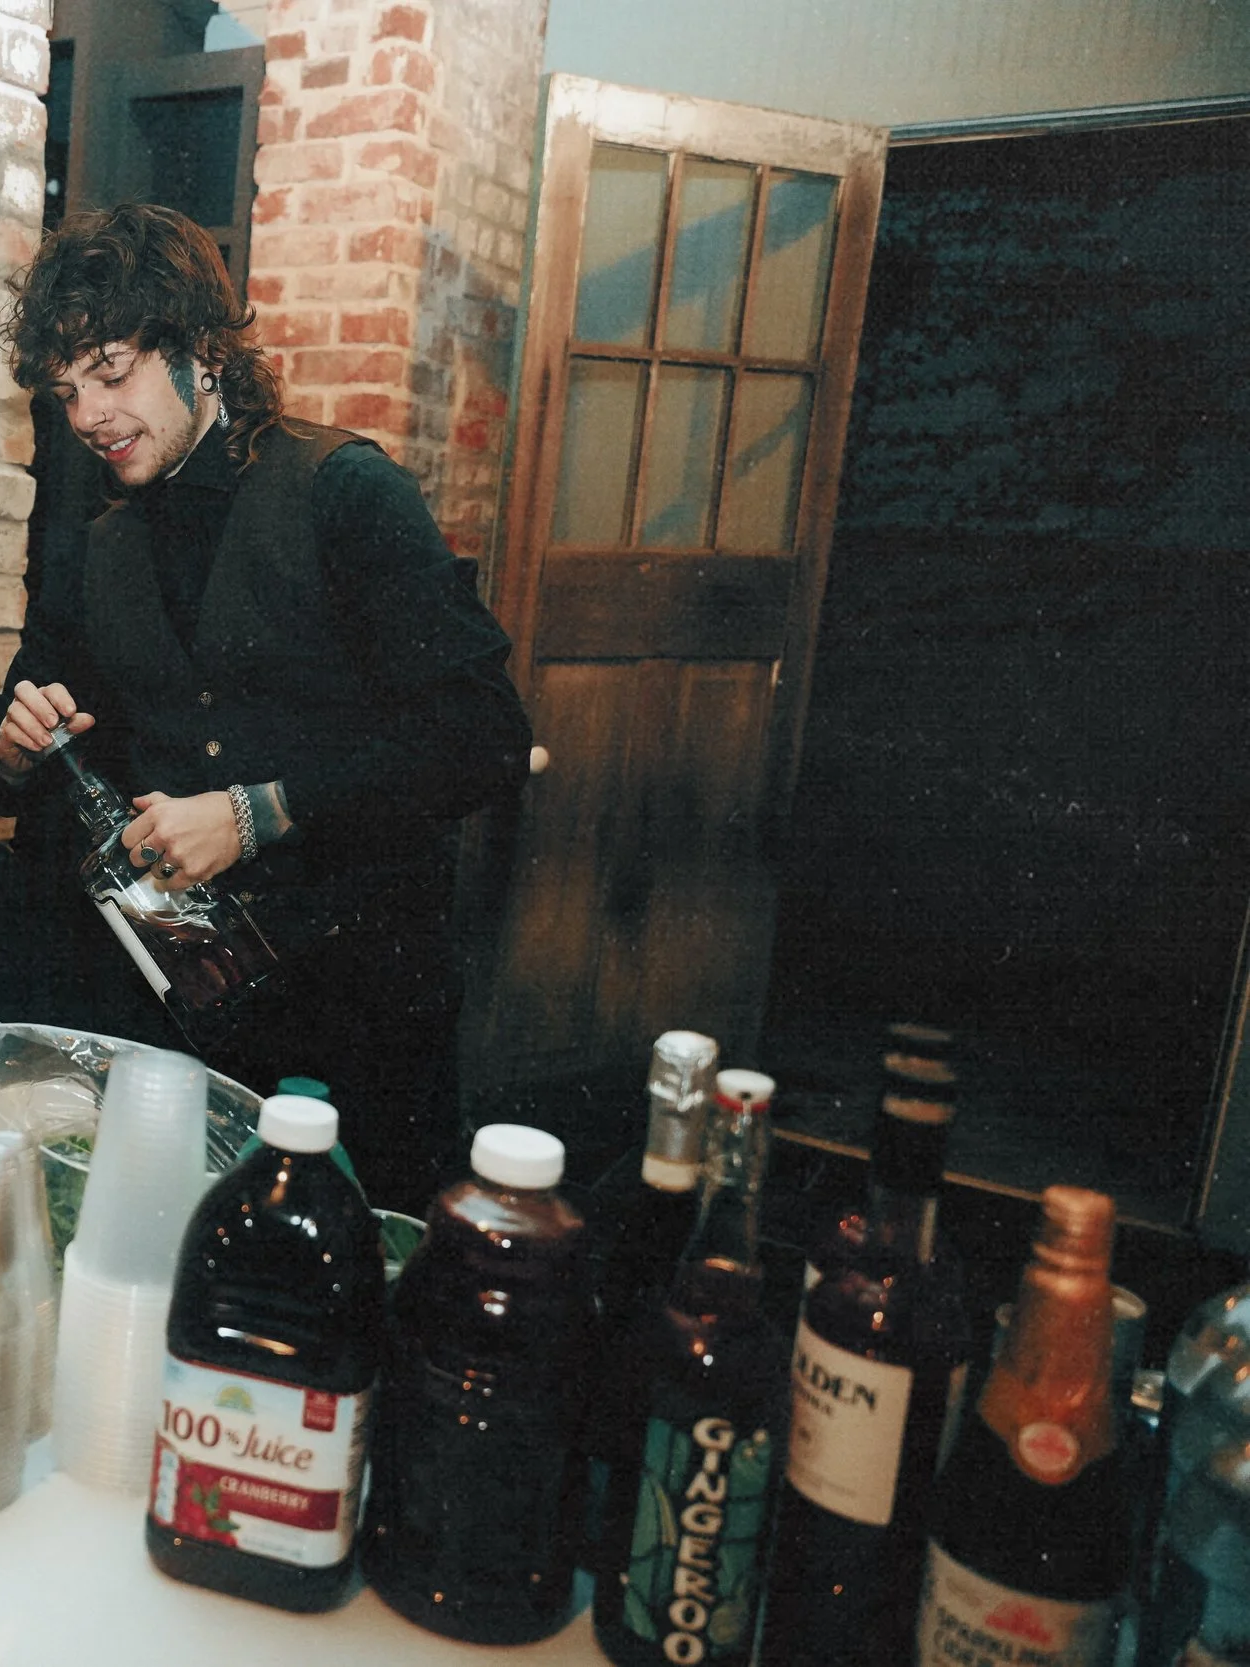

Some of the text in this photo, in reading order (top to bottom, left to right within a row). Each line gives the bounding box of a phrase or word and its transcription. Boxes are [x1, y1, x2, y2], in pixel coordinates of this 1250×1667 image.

[234, 1423, 315, 1470] Juice
[218, 1475, 311, 1511] CRANBERRY
[662, 1416, 735, 1666] GINGEROO
